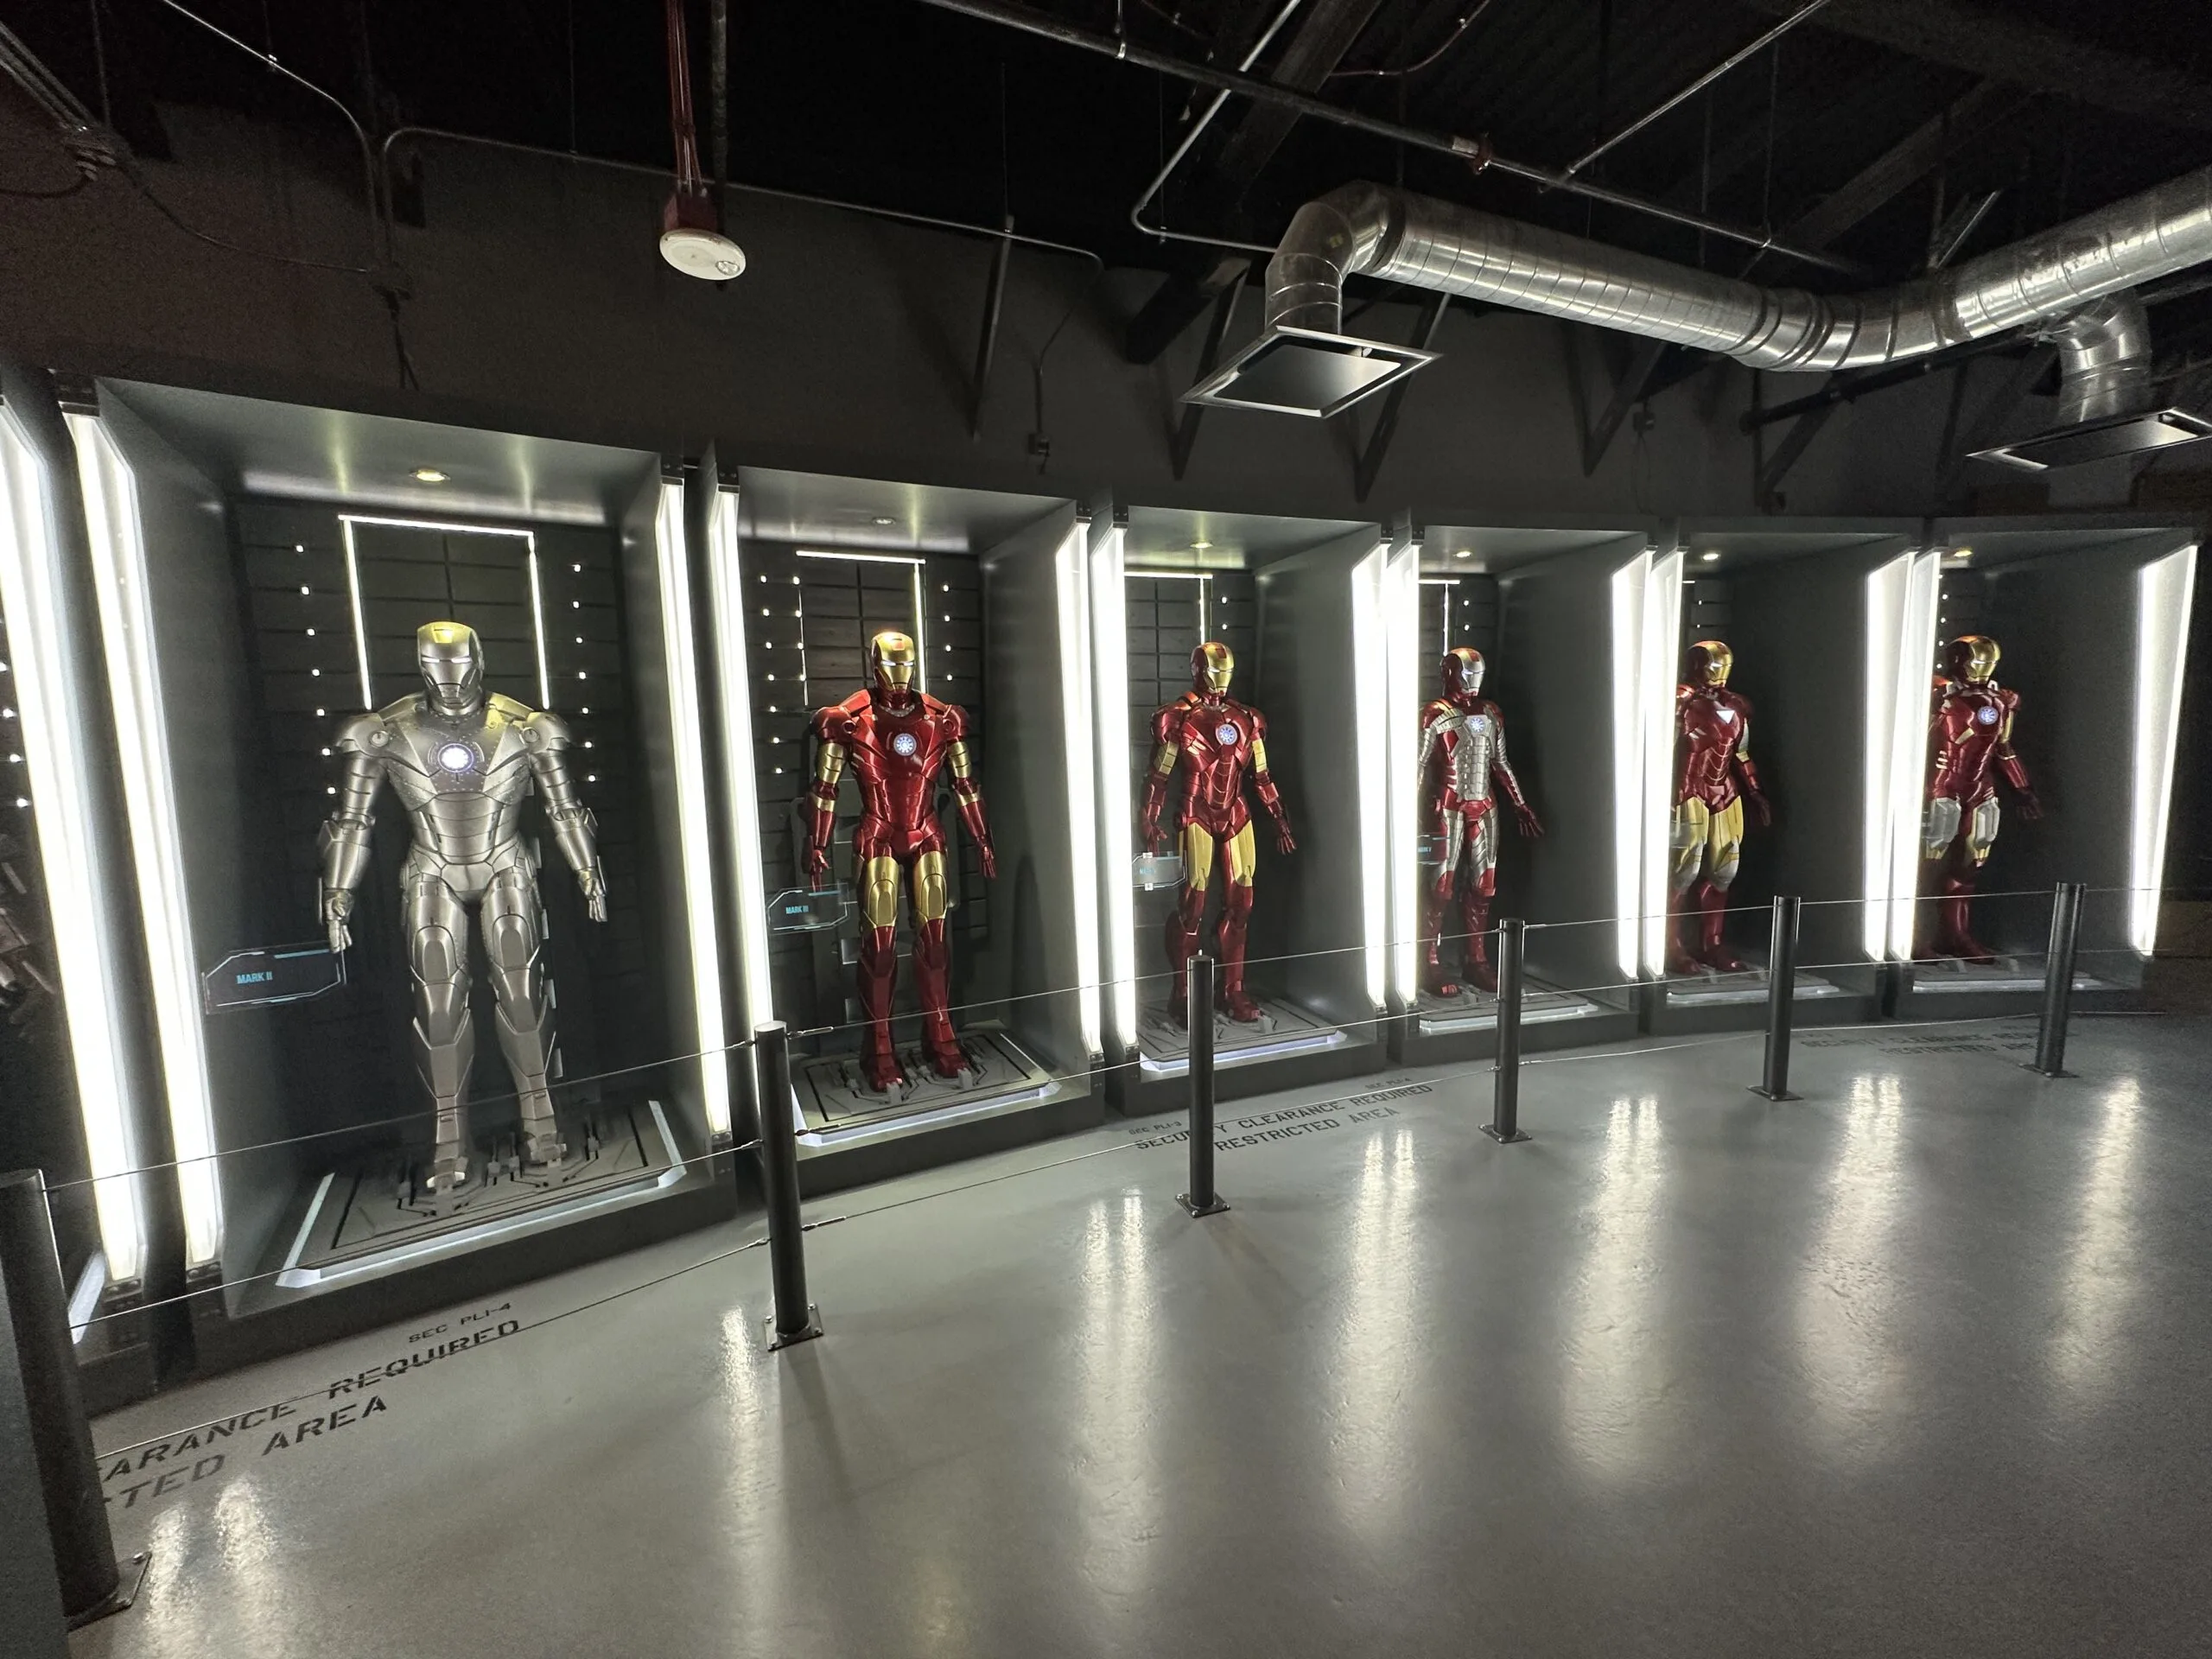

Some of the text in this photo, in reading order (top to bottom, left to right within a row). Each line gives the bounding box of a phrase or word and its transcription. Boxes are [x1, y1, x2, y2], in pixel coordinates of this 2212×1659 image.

[785, 906, 802, 914] MARK
[236, 971, 273, 984] MARK II
[1238, 1101, 1344, 1128] CLEARANCE
[1350, 1084, 1433, 1108] REQUIRED
[1214, 1106, 1402, 1151] RESTRICTED AREA
[408, 1324, 448, 1343] SEC
[328, 1319, 519, 1400] REQUIRED
[262, 1395, 387, 1456] AREA
